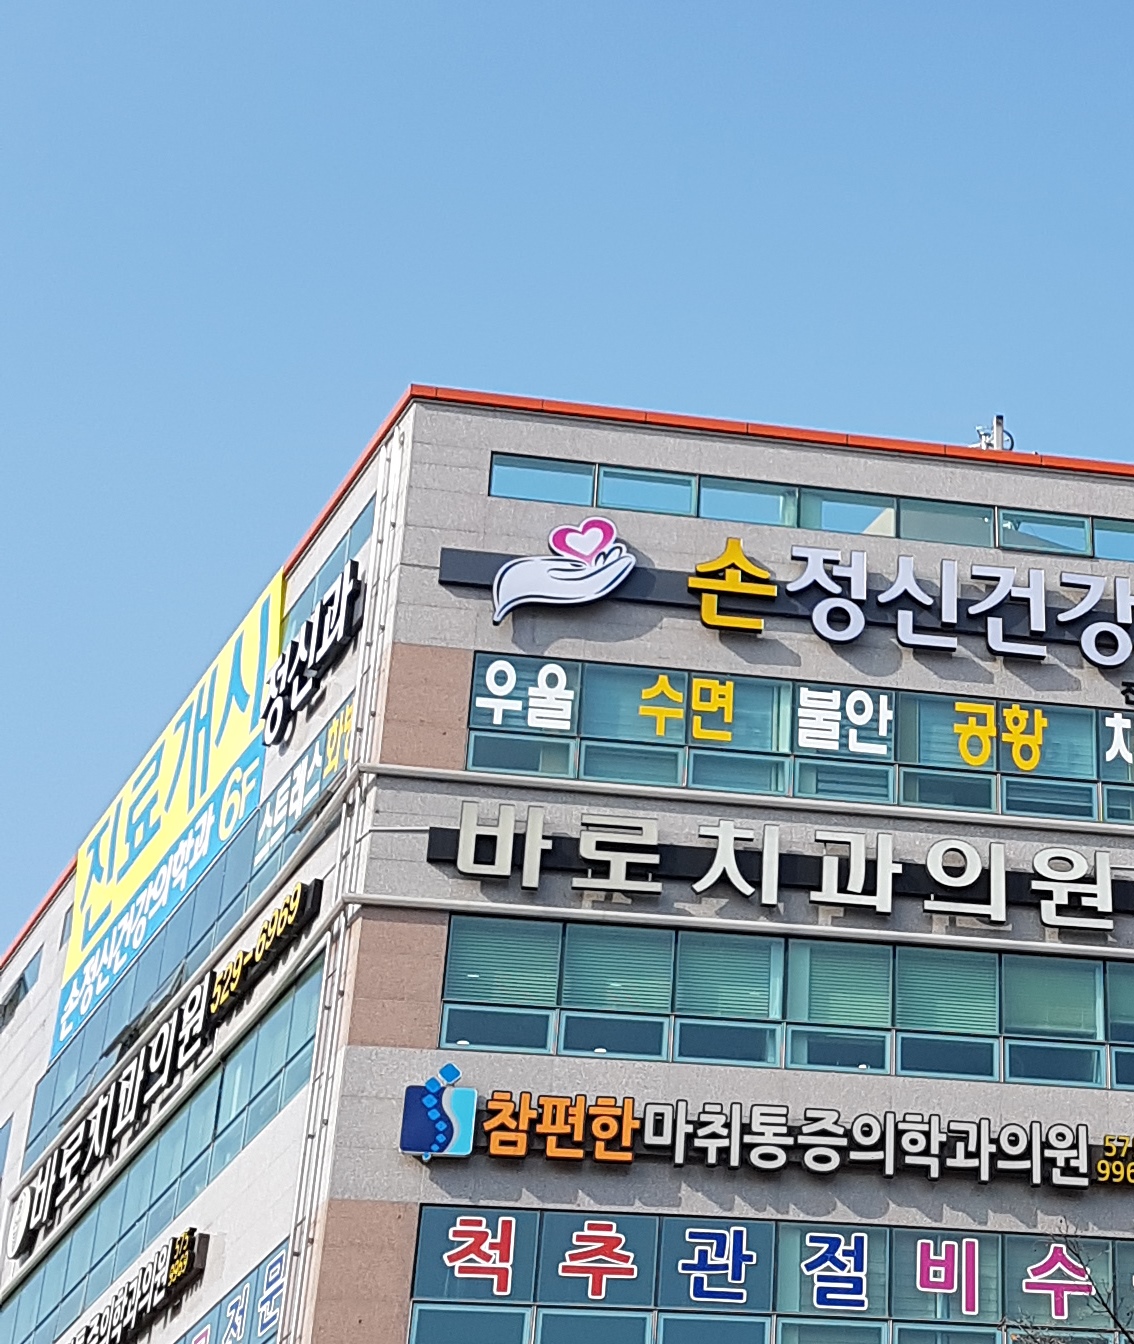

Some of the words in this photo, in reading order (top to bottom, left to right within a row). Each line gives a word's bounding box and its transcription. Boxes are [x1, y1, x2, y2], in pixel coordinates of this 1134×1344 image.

[264, 560, 357, 745] 정신과
[475, 659, 575, 730] 우울
[638, 674, 733, 741] 수면
[797, 687, 893, 755] 불안
[953, 701, 1048, 772] 공황
[80, 594, 272, 954] 진료개시
[217, 756, 260, 838] 6F
[254, 740, 322, 868] 스트레스
[456, 800, 1114, 932] 바로치과의원
[29, 972, 210, 1230] 바로치과의원
[209, 881, 303, 1014] 529-6969
[443, 1216, 638, 1300] 척추
[677, 1226, 869, 1312] 관절
